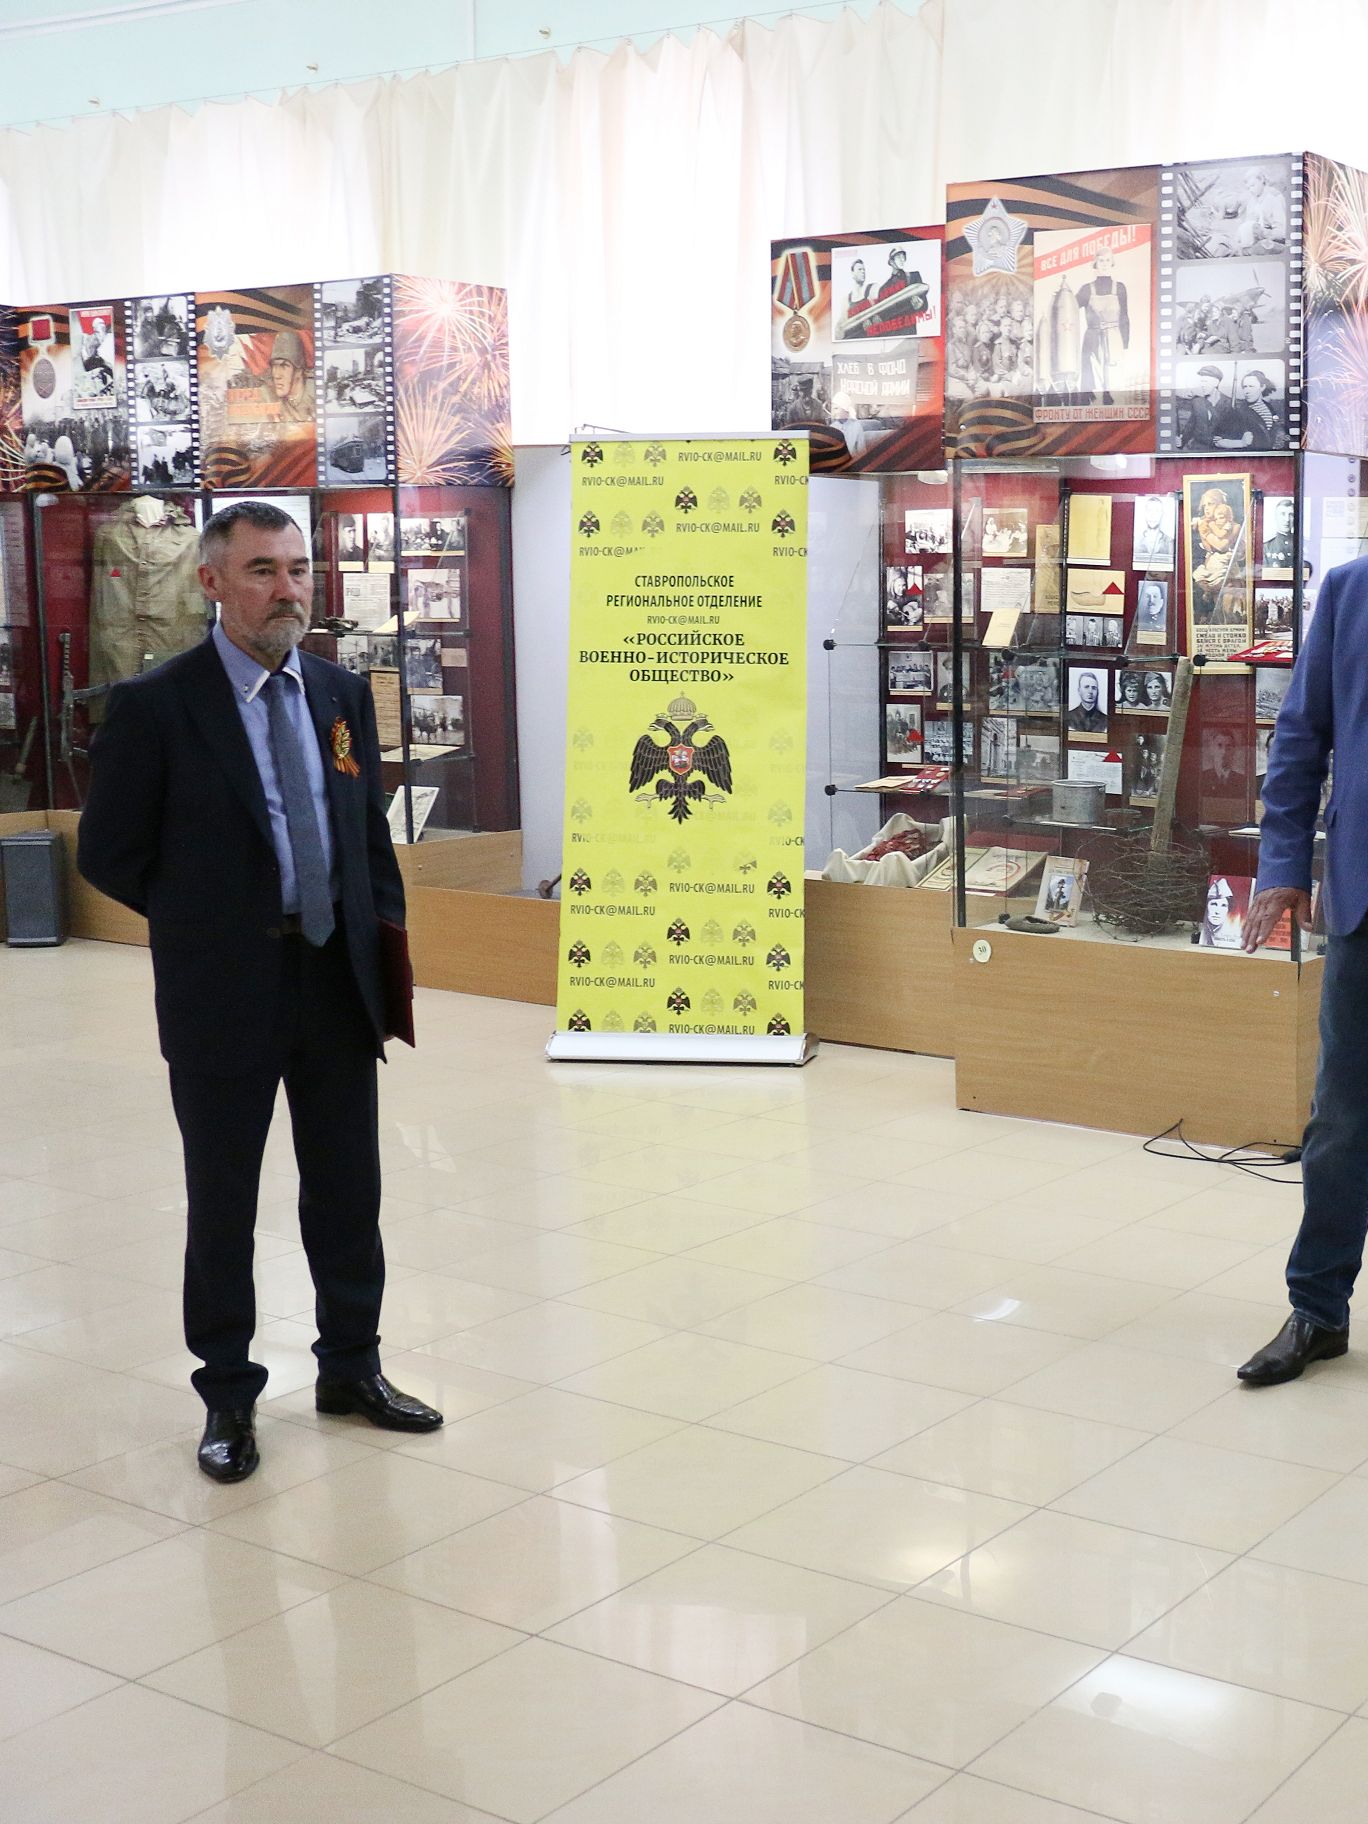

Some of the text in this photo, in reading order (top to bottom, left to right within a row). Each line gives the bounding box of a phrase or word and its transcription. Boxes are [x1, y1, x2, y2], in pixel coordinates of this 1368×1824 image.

[1041, 225, 1137, 271] ВСЕ ДЛЯ ПОБЕДЫ!
[1035, 408, 1070, 420] ФРОНТУ
[1073, 408, 1082, 420] ОТ
[1085, 407, 1124, 420] ЖЕНЩИН
[678, 451, 762, 463] RVIO-CK@MAIL.RU
[581, 476, 664, 488] RVIO-CK@MAIL.RU
[676, 522, 760, 534] RVIO-CK@MAIL.RU
[634, 575, 735, 588] СТАВРОПОЛЬСКОЕ
[606, 595, 763, 609] РЕГИОНАЛЬНОЕ ОТДЕЛЕНИЕ
[647, 615, 720, 626] RVIO-CK@MAIL.RU
[623, 630, 745, 647] «РОССИЙСКОЕ
[579, 651, 789, 666] ВОЕННО-ИСТОРИЧЕСКОЕ
[629, 669, 734, 684] ОБЩЕСТВО»
[669, 882, 755, 894] RVIO-CK@MAIL.RU
[570, 905, 656, 917] RVIO-CK@MAIL.RU
[669, 954, 755, 967] RVIO-CK@MAIL.RU
[569, 977, 656, 989] RVIO-CK@MAIL.RU
